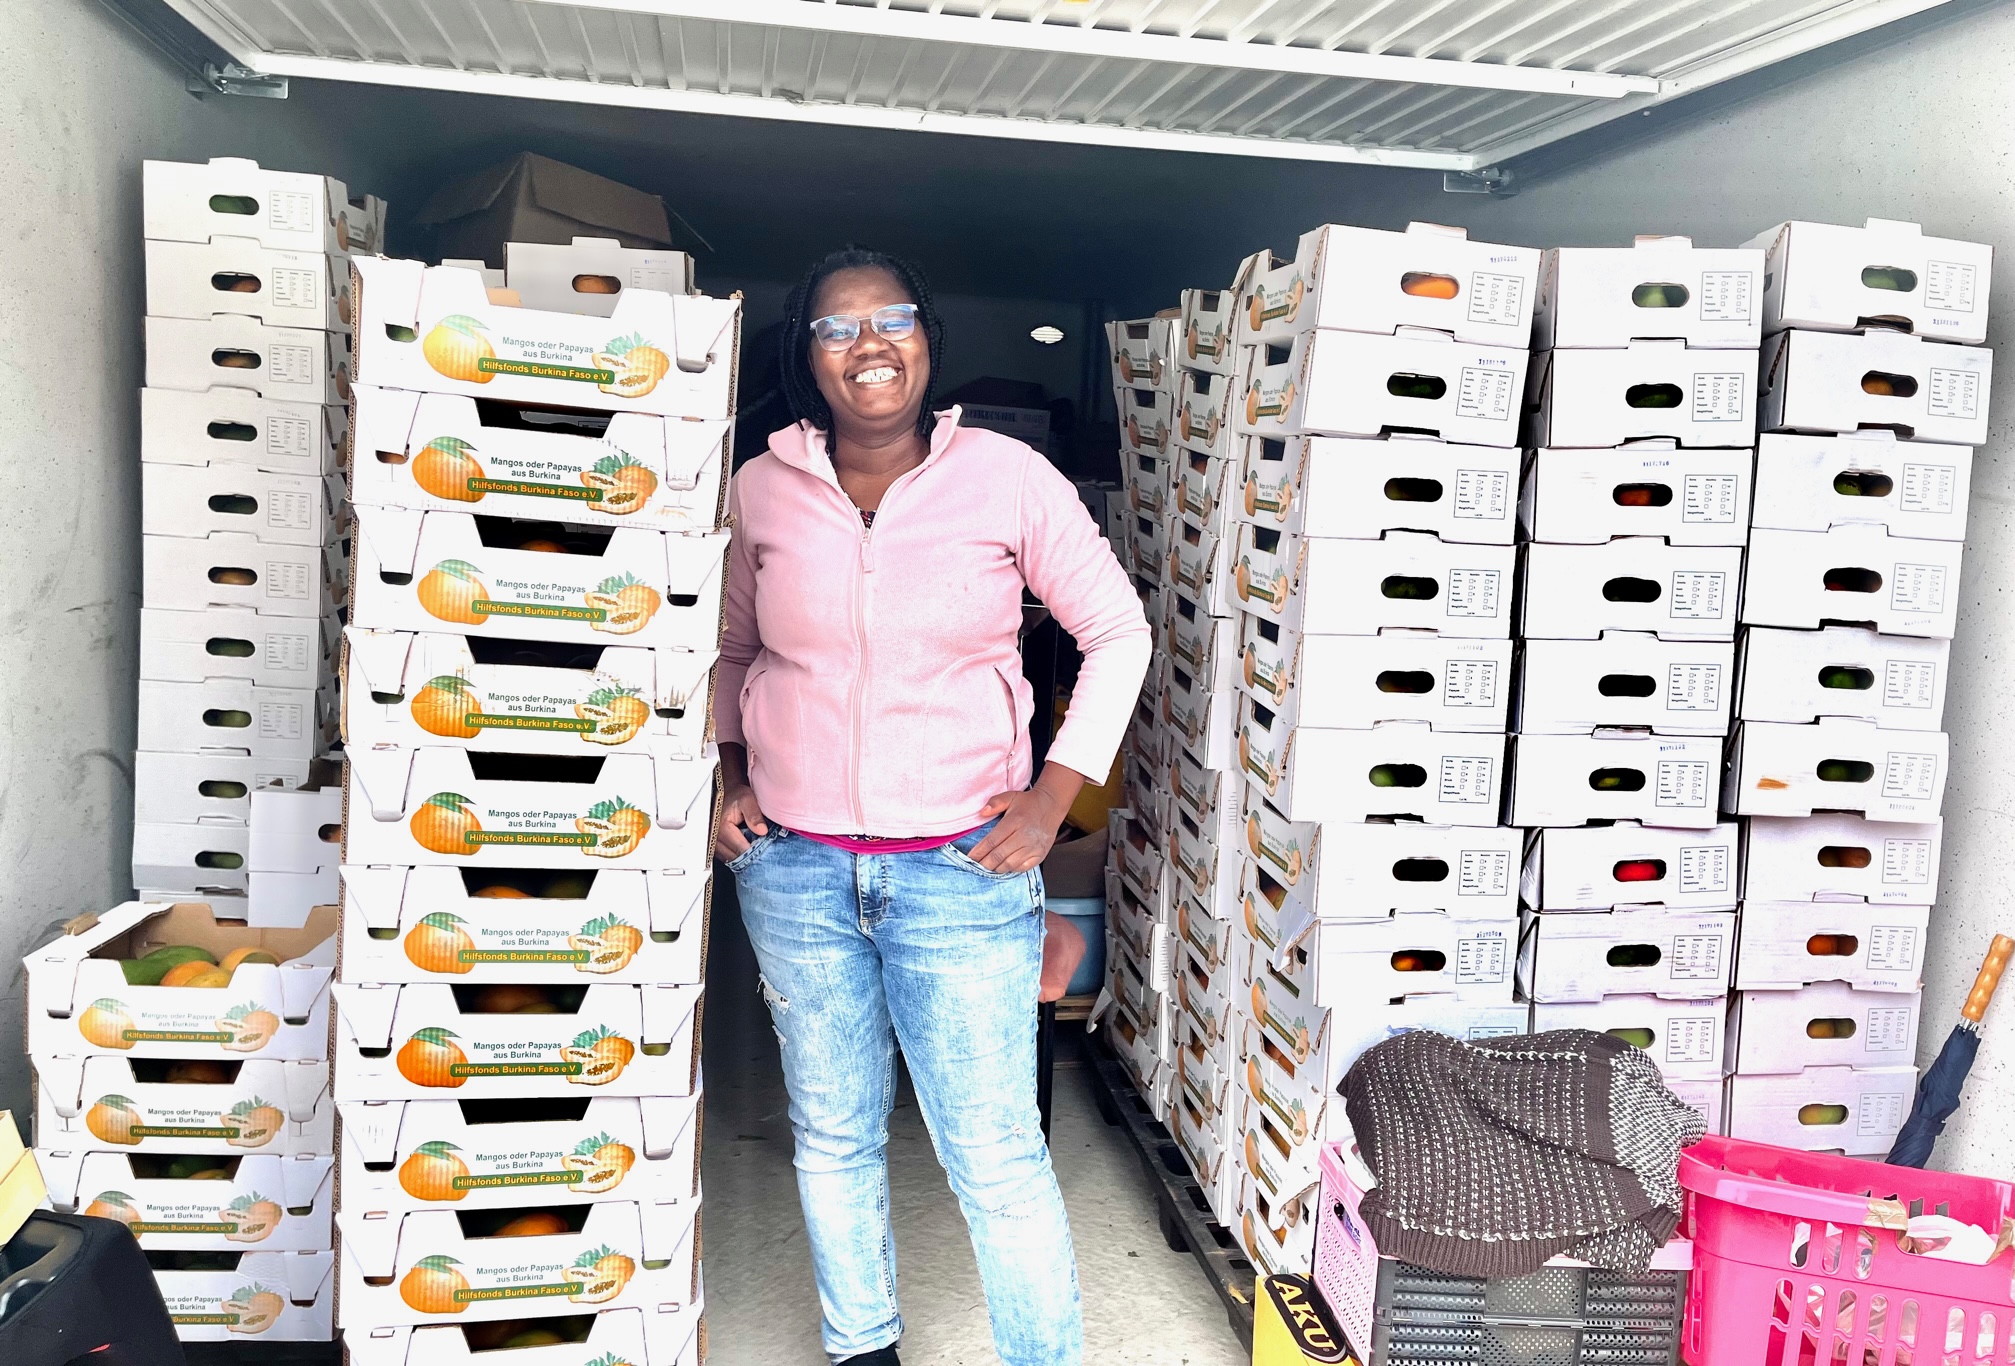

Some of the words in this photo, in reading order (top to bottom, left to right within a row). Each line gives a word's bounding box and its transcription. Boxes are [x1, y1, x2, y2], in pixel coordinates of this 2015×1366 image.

[502, 336, 536, 348] Mangos
[537, 341, 558, 350] oder
[559, 342, 594, 354] Papayas
[540, 350, 573, 362] Burkina
[483, 361, 529, 373] Hilfsfonds
[532, 365, 567, 377] Burkina
[569, 369, 591, 379] Faso
[490, 456, 524, 468] Mangos
[525, 461, 546, 469] oder
[547, 462, 582, 473] Papayas
[528, 470, 561, 480] Burkina
[472, 481, 518, 492] Hilfsfonds
[520, 484, 556, 495] Burkina
[558, 488, 580, 497] Faso
[496, 579, 528, 590] Mangos
[530, 582, 550, 591] oder
[551, 583, 586, 595] Papayas
[533, 591, 565, 602] Burkina
[477, 603, 522, 614] Hilfsfonds
[525, 606, 559, 616] Burkina
[562, 609, 584, 618] Faso
[488, 692, 520, 703] Mangos
[522, 695, 542, 703] oder
[542, 695, 577, 706] Papayas
[524, 704, 556, 713] Burkina
[470, 716, 514, 726] Hilfsfonds
[516, 718, 550, 728] Burkina
[553, 720, 574, 729] Faso
[488, 809, 520, 819] Mangos
[543, 810, 578, 820] Papayas
[525, 819, 556, 828] Burkina
[470, 833, 514, 843] Hilfsfonds
[517, 834, 551, 843] Burkina
[553, 835, 575, 844] Faso
[481, 928, 513, 938] Mangos
[536, 928, 570, 937] Papayas
[518, 938, 550, 946] Burkina
[463, 952, 508, 961] Hilfsfonds
[510, 952, 544, 961] Burkina
[546, 952, 568, 961] Faso
[473, 1042, 506, 1051] Mangos
[528, 1041, 562, 1051] Papayas
[455, 1066, 500, 1074] Hilfsfonds
[147, 1108, 174, 1116] Mangos
[475, 1154, 508, 1162] Mangos
[530, 1151, 564, 1160] Papayas
[512, 1161, 543, 1169] Burkina
[457, 1178, 502, 1187] Hilfsfonds
[504, 1176, 538, 1184] Burkina
[146, 1204, 173, 1212] Mangos
[476, 1267, 508, 1276] Mangos
[458, 1290, 502, 1300] Hilfsfonds
[505, 1288, 538, 1297] Burkina
[1272, 1280, 1338, 1350] AKU
